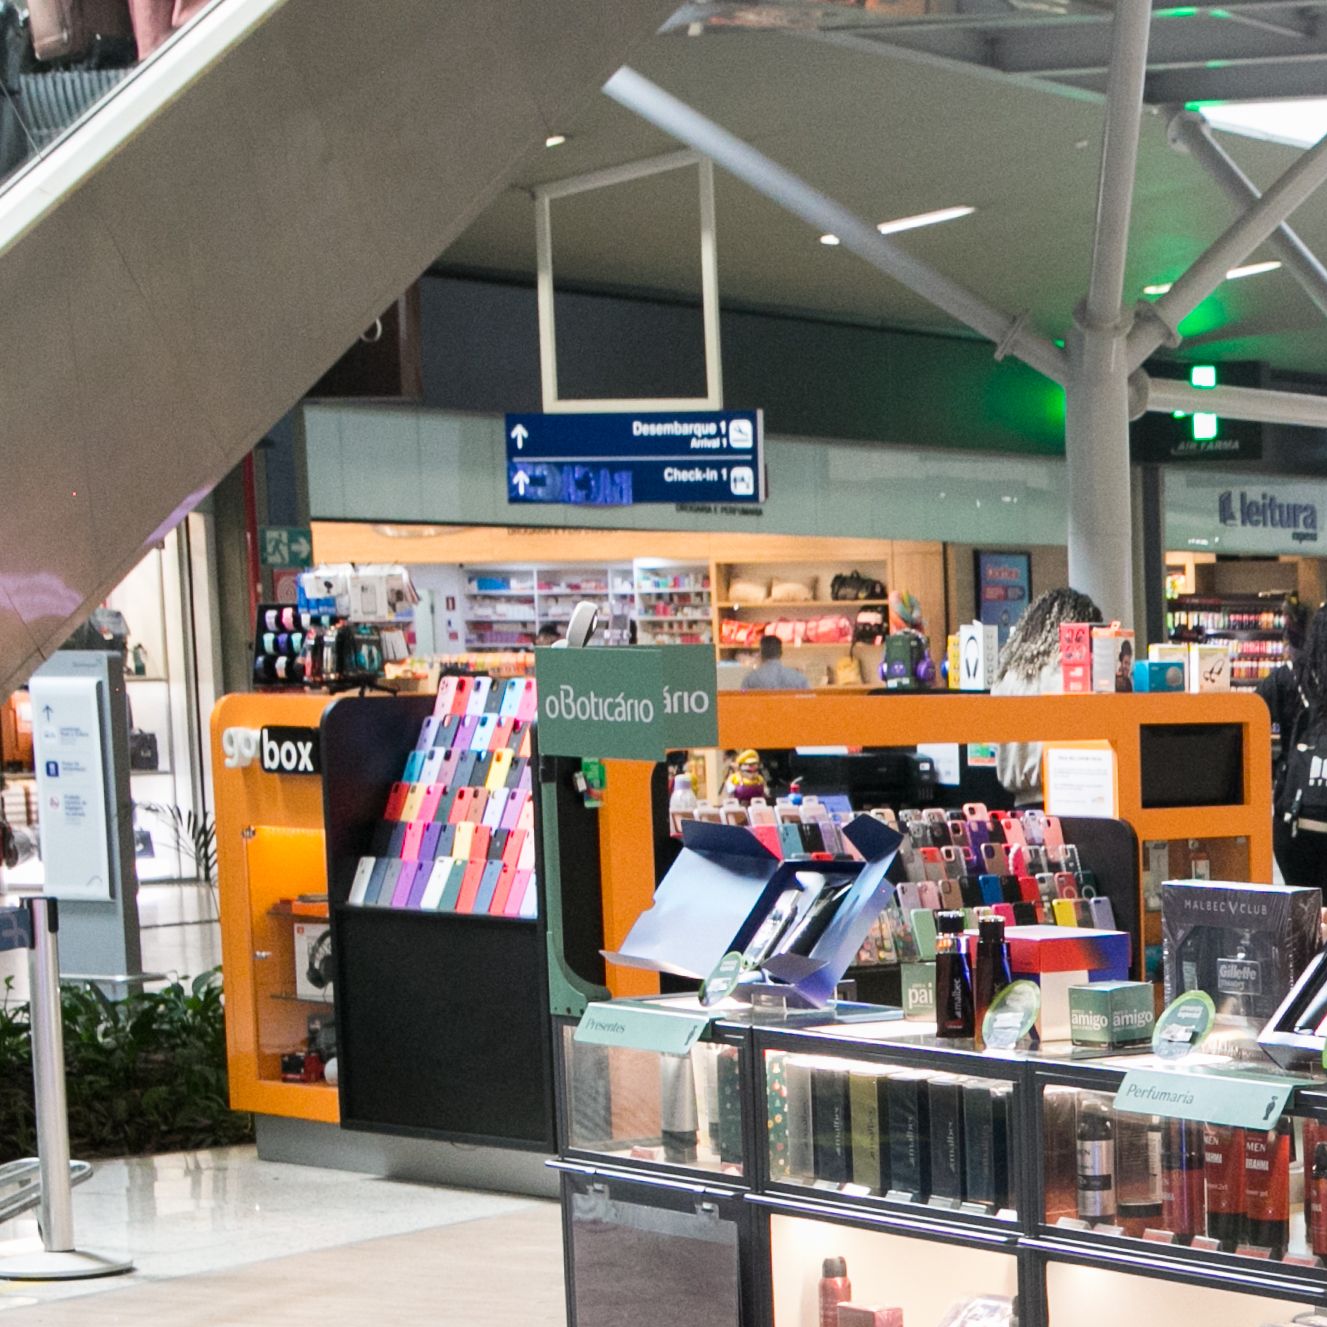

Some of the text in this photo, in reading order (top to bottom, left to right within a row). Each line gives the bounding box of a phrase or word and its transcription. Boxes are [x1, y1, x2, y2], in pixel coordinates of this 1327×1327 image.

[633, 420, 726, 437] Desembarque 1
[690, 437, 720, 448] Arrival
[664, 467, 727, 482] Check-in 1
[1240, 492, 1318, 530] leitura
[545, 684, 655, 724] oBoticário
[222, 727, 315, 772] go box
[1184, 899, 1226, 912] MALBEC
[1240, 903, 1268, 916] CLUB
[1219, 964, 1258, 981] Gillette
[908, 982, 933, 1009] pai
[584, 1018, 626, 1033] Presentes
[1071, 1009, 1109, 1029] amigo
[1112, 1009, 1153, 1029] amigo
[1126, 1083, 1194, 1105] Perfumaria
[1246, 1142, 1266, 1153] MEN
